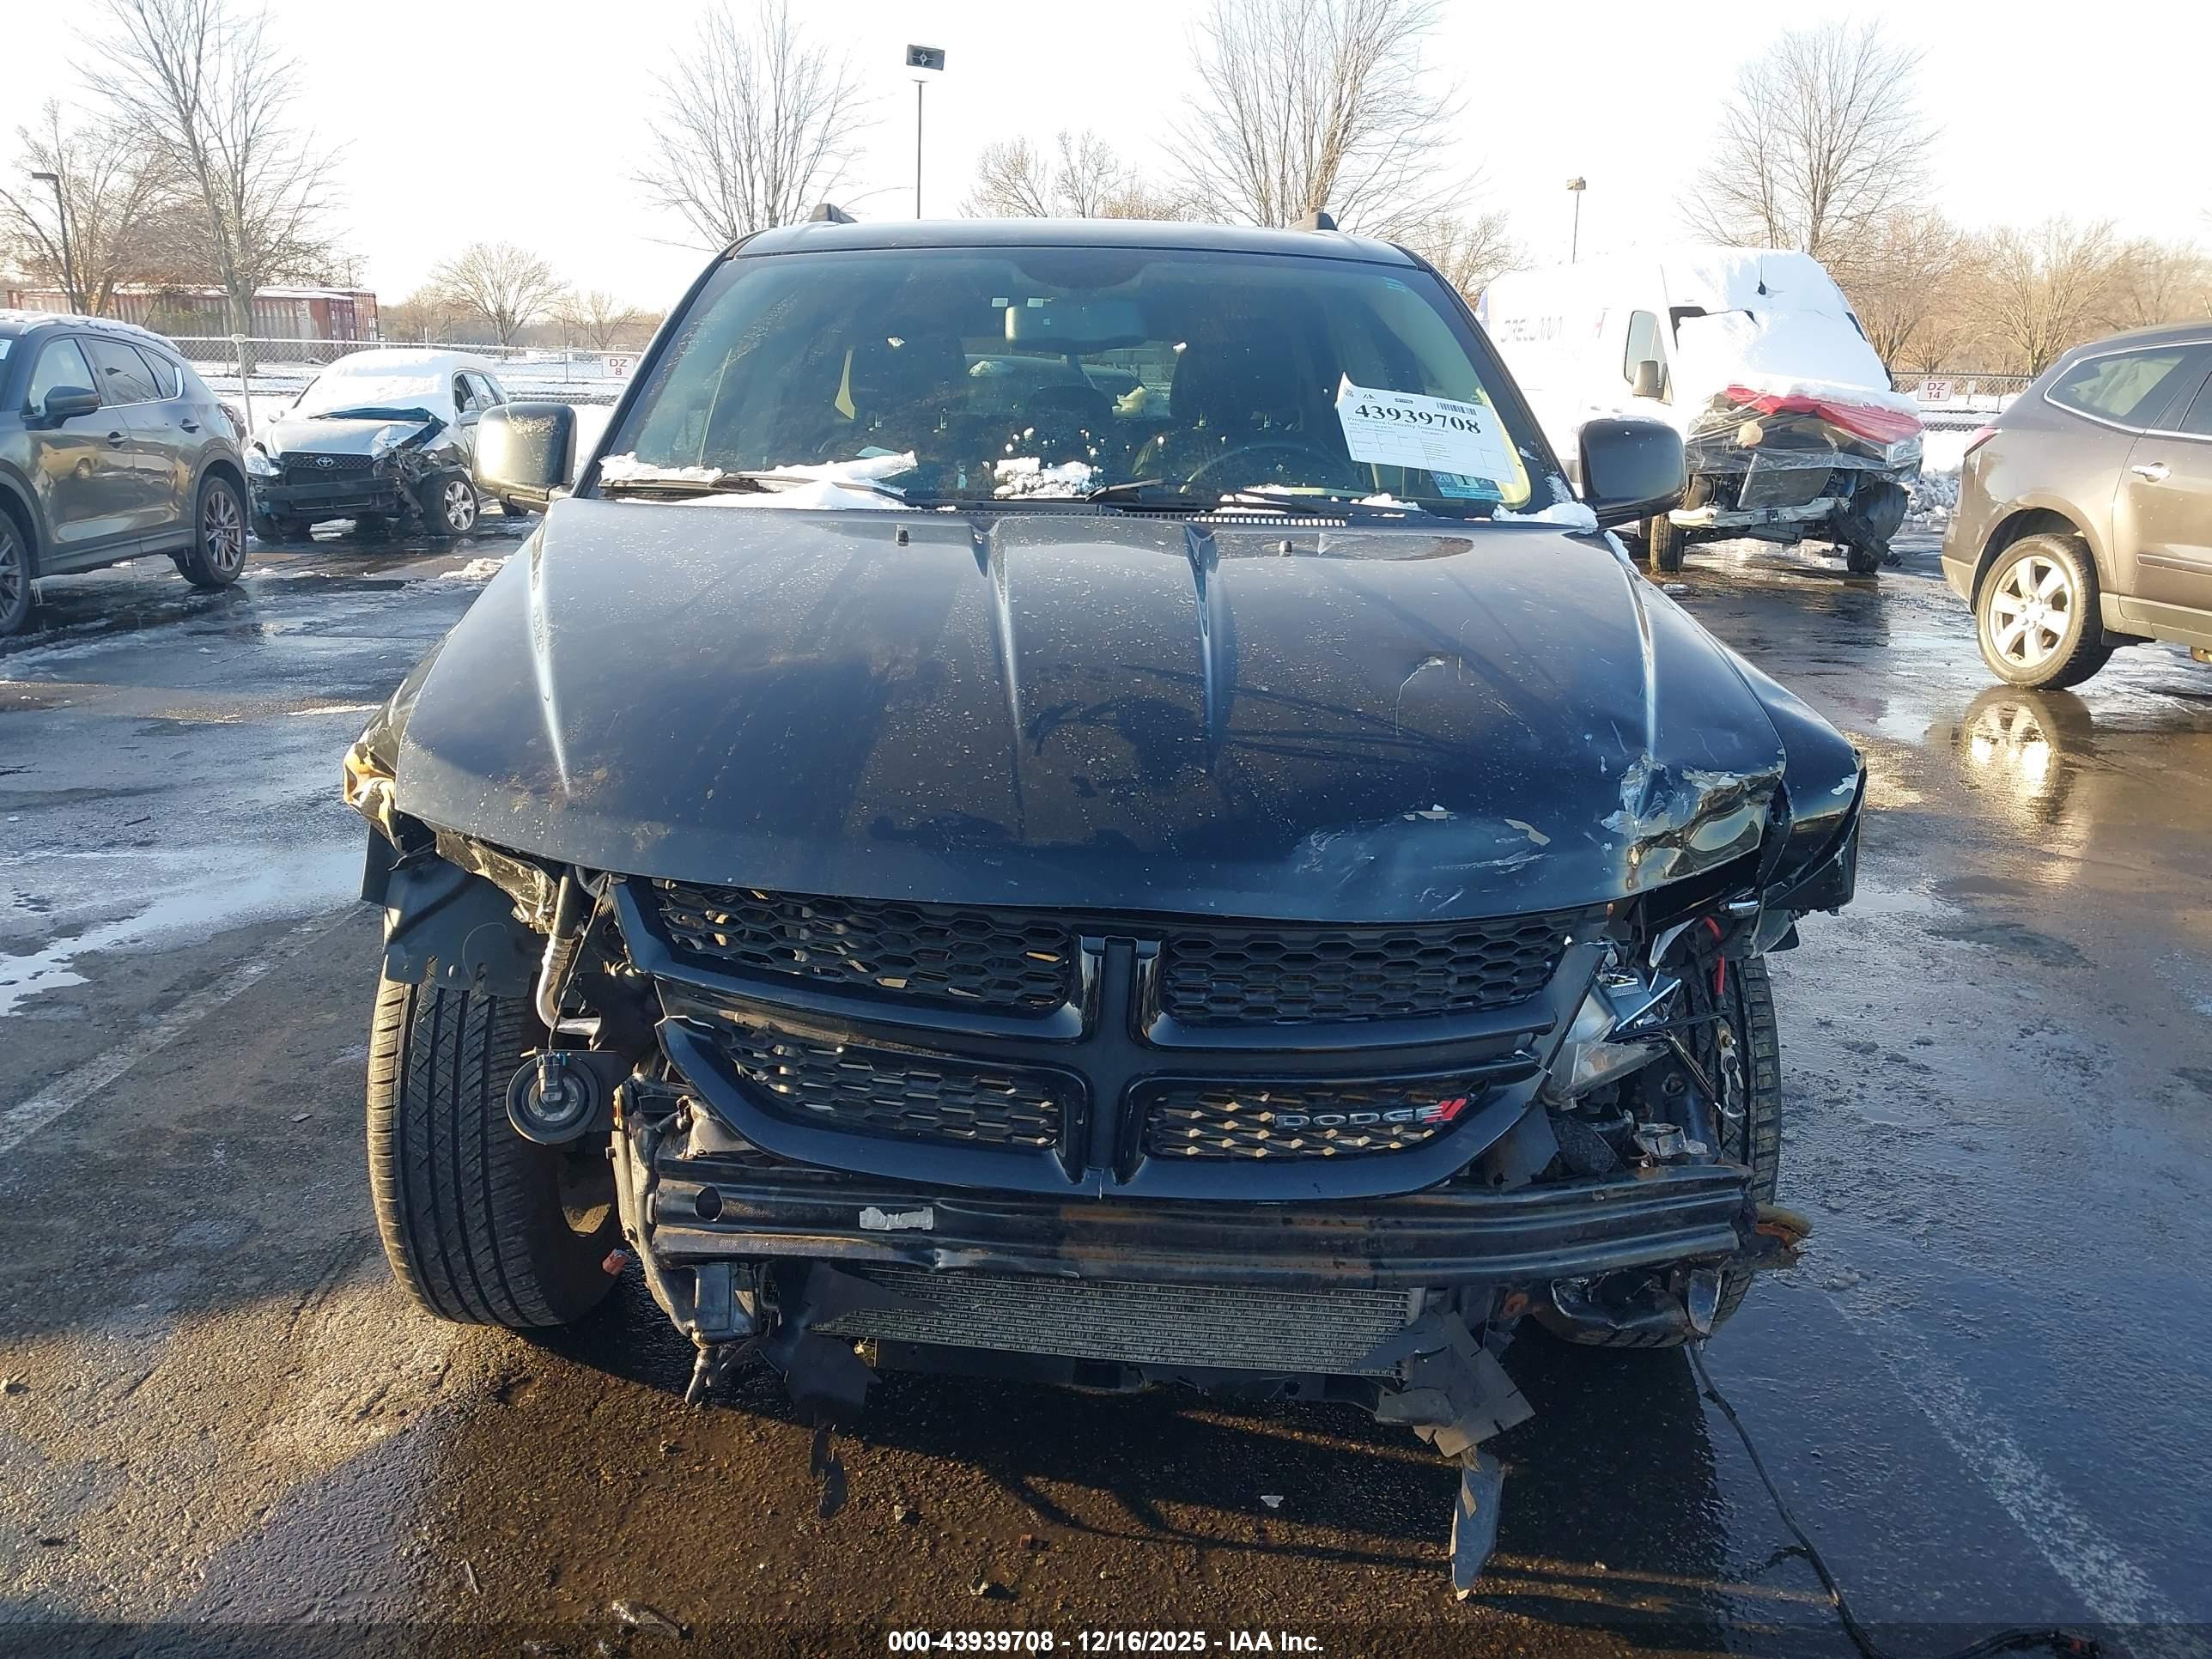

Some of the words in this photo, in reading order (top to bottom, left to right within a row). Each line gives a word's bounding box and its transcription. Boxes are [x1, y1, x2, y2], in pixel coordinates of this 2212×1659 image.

[610, 359, 628, 368] DZ
[1927, 382, 1946, 391] DZ
[1347, 416, 1387, 425] Progressive
[1355, 404, 1481, 434] 43939708
[1274, 1104, 1443, 1129] DODGE
